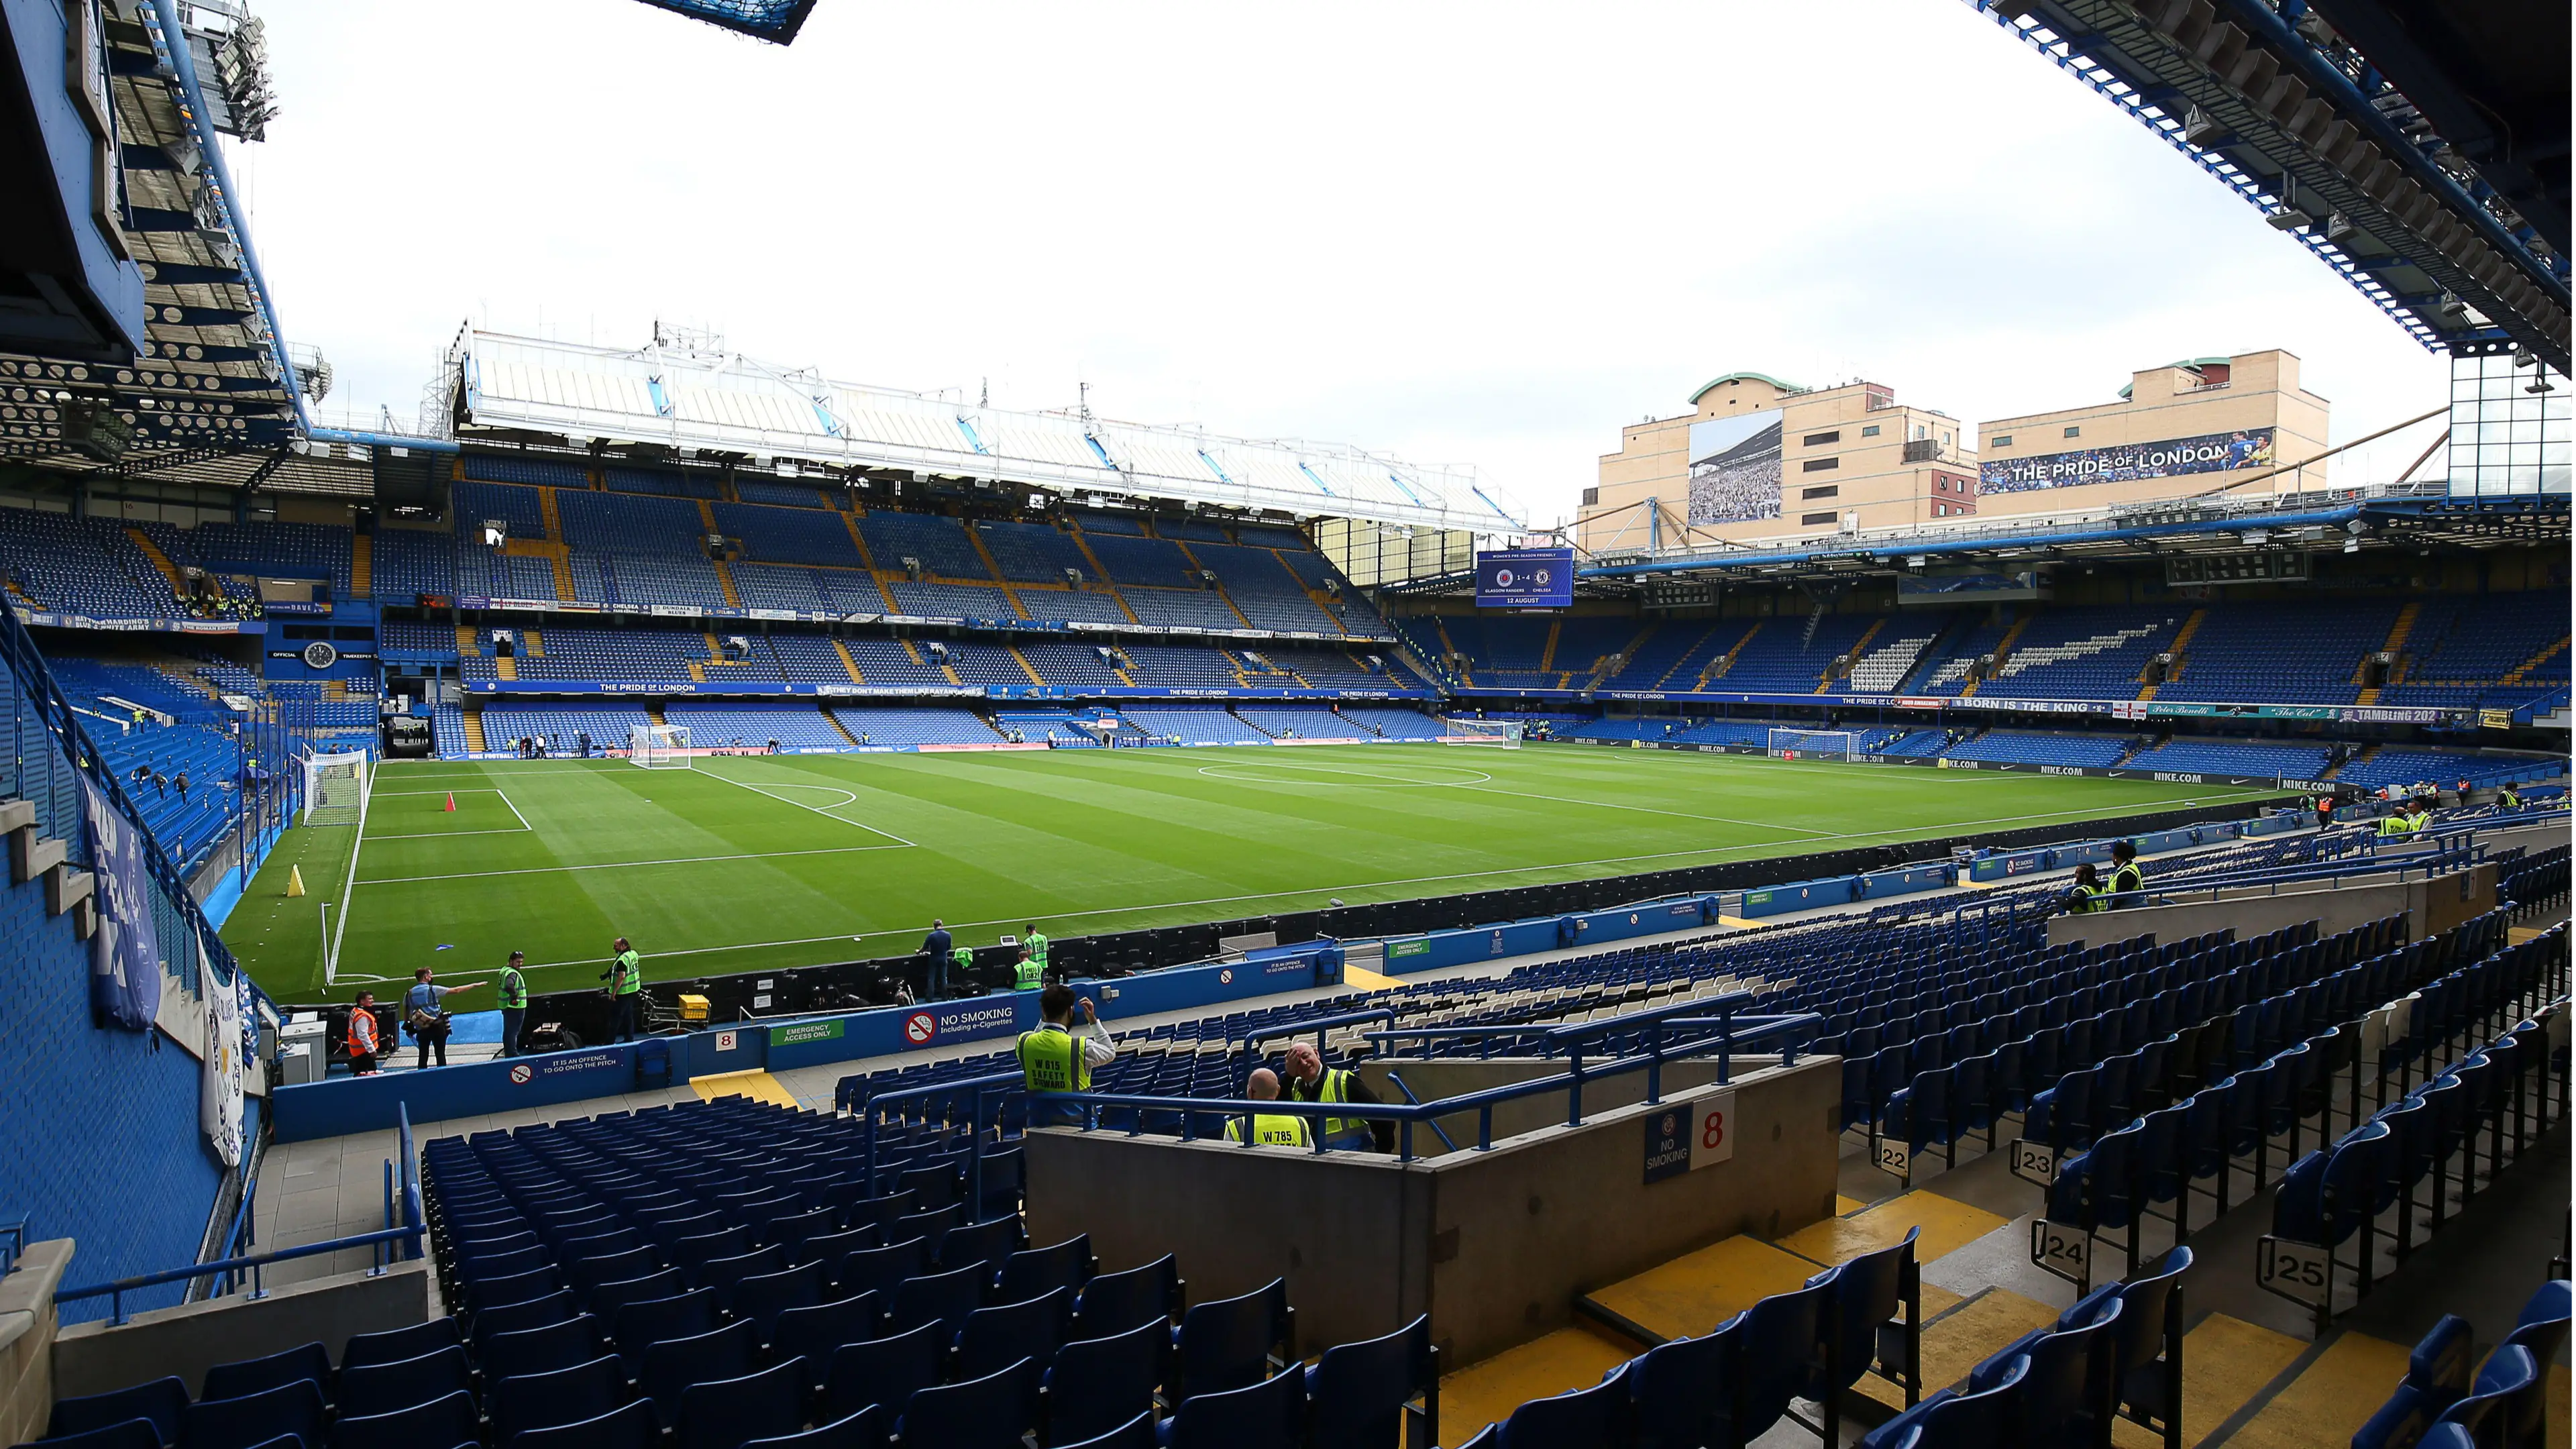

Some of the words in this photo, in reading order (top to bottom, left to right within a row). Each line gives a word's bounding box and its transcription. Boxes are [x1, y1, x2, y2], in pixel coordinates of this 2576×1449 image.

[2013, 464, 2047, 482] THE
[2051, 458, 2110, 478] PRIDE
[2114, 455, 2134, 468] OF
[2138, 443, 2230, 469] LONDON
[1964, 699, 2002, 708] BORN
[2004, 700, 2016, 710] IS
[2022, 702, 2049, 711] THE
[2053, 703, 2088, 712] KING
[2152, 705, 2174, 714] Peter
[2176, 706, 2209, 715] Bonetti
[2357, 710, 2411, 721] TAMBLING
[2414, 710, 2435, 722] 202
[1851, 754, 1884, 763] NIKE.COM
[1947, 760, 1978, 769] IKE.COM
[2041, 766, 2082, 776] NIKE.COM
[2155, 773, 2202, 784] NIKE.COM
[2283, 780, 2335, 792] NIKE.COM
[941, 1015, 958, 1026] NO
[961, 1007, 1012, 1023] SMOKING
[786, 1024, 829, 1035] EMERGENCY
[941, 1025, 971, 1034] Including
[973, 1018, 1013, 1028] e-Cigarettes
[720, 1035, 731, 1046] 8
[784, 1034, 812, 1042] ACCESS
[814, 1030, 831, 1038] ONLY
[578, 1055, 606, 1063] OFFENCE
[1034, 1059, 1042, 1068] W
[1045, 1060, 1060, 1070] 615
[1032, 1069, 1065, 1080] SAFETY
[1263, 1131, 1272, 1142] W
[1275, 1131, 1292, 1142] 785
[1703, 1112, 1723, 1149] 8
[1661, 1138, 1674, 1152] NO
[1646, 1148, 1688, 1170] SMOKING
[1881, 1148, 1906, 1169] 22
[2022, 1151, 2051, 1174] 23
[2047, 1234, 2084, 1266] 24
[2278, 1254, 2326, 1287] 25
